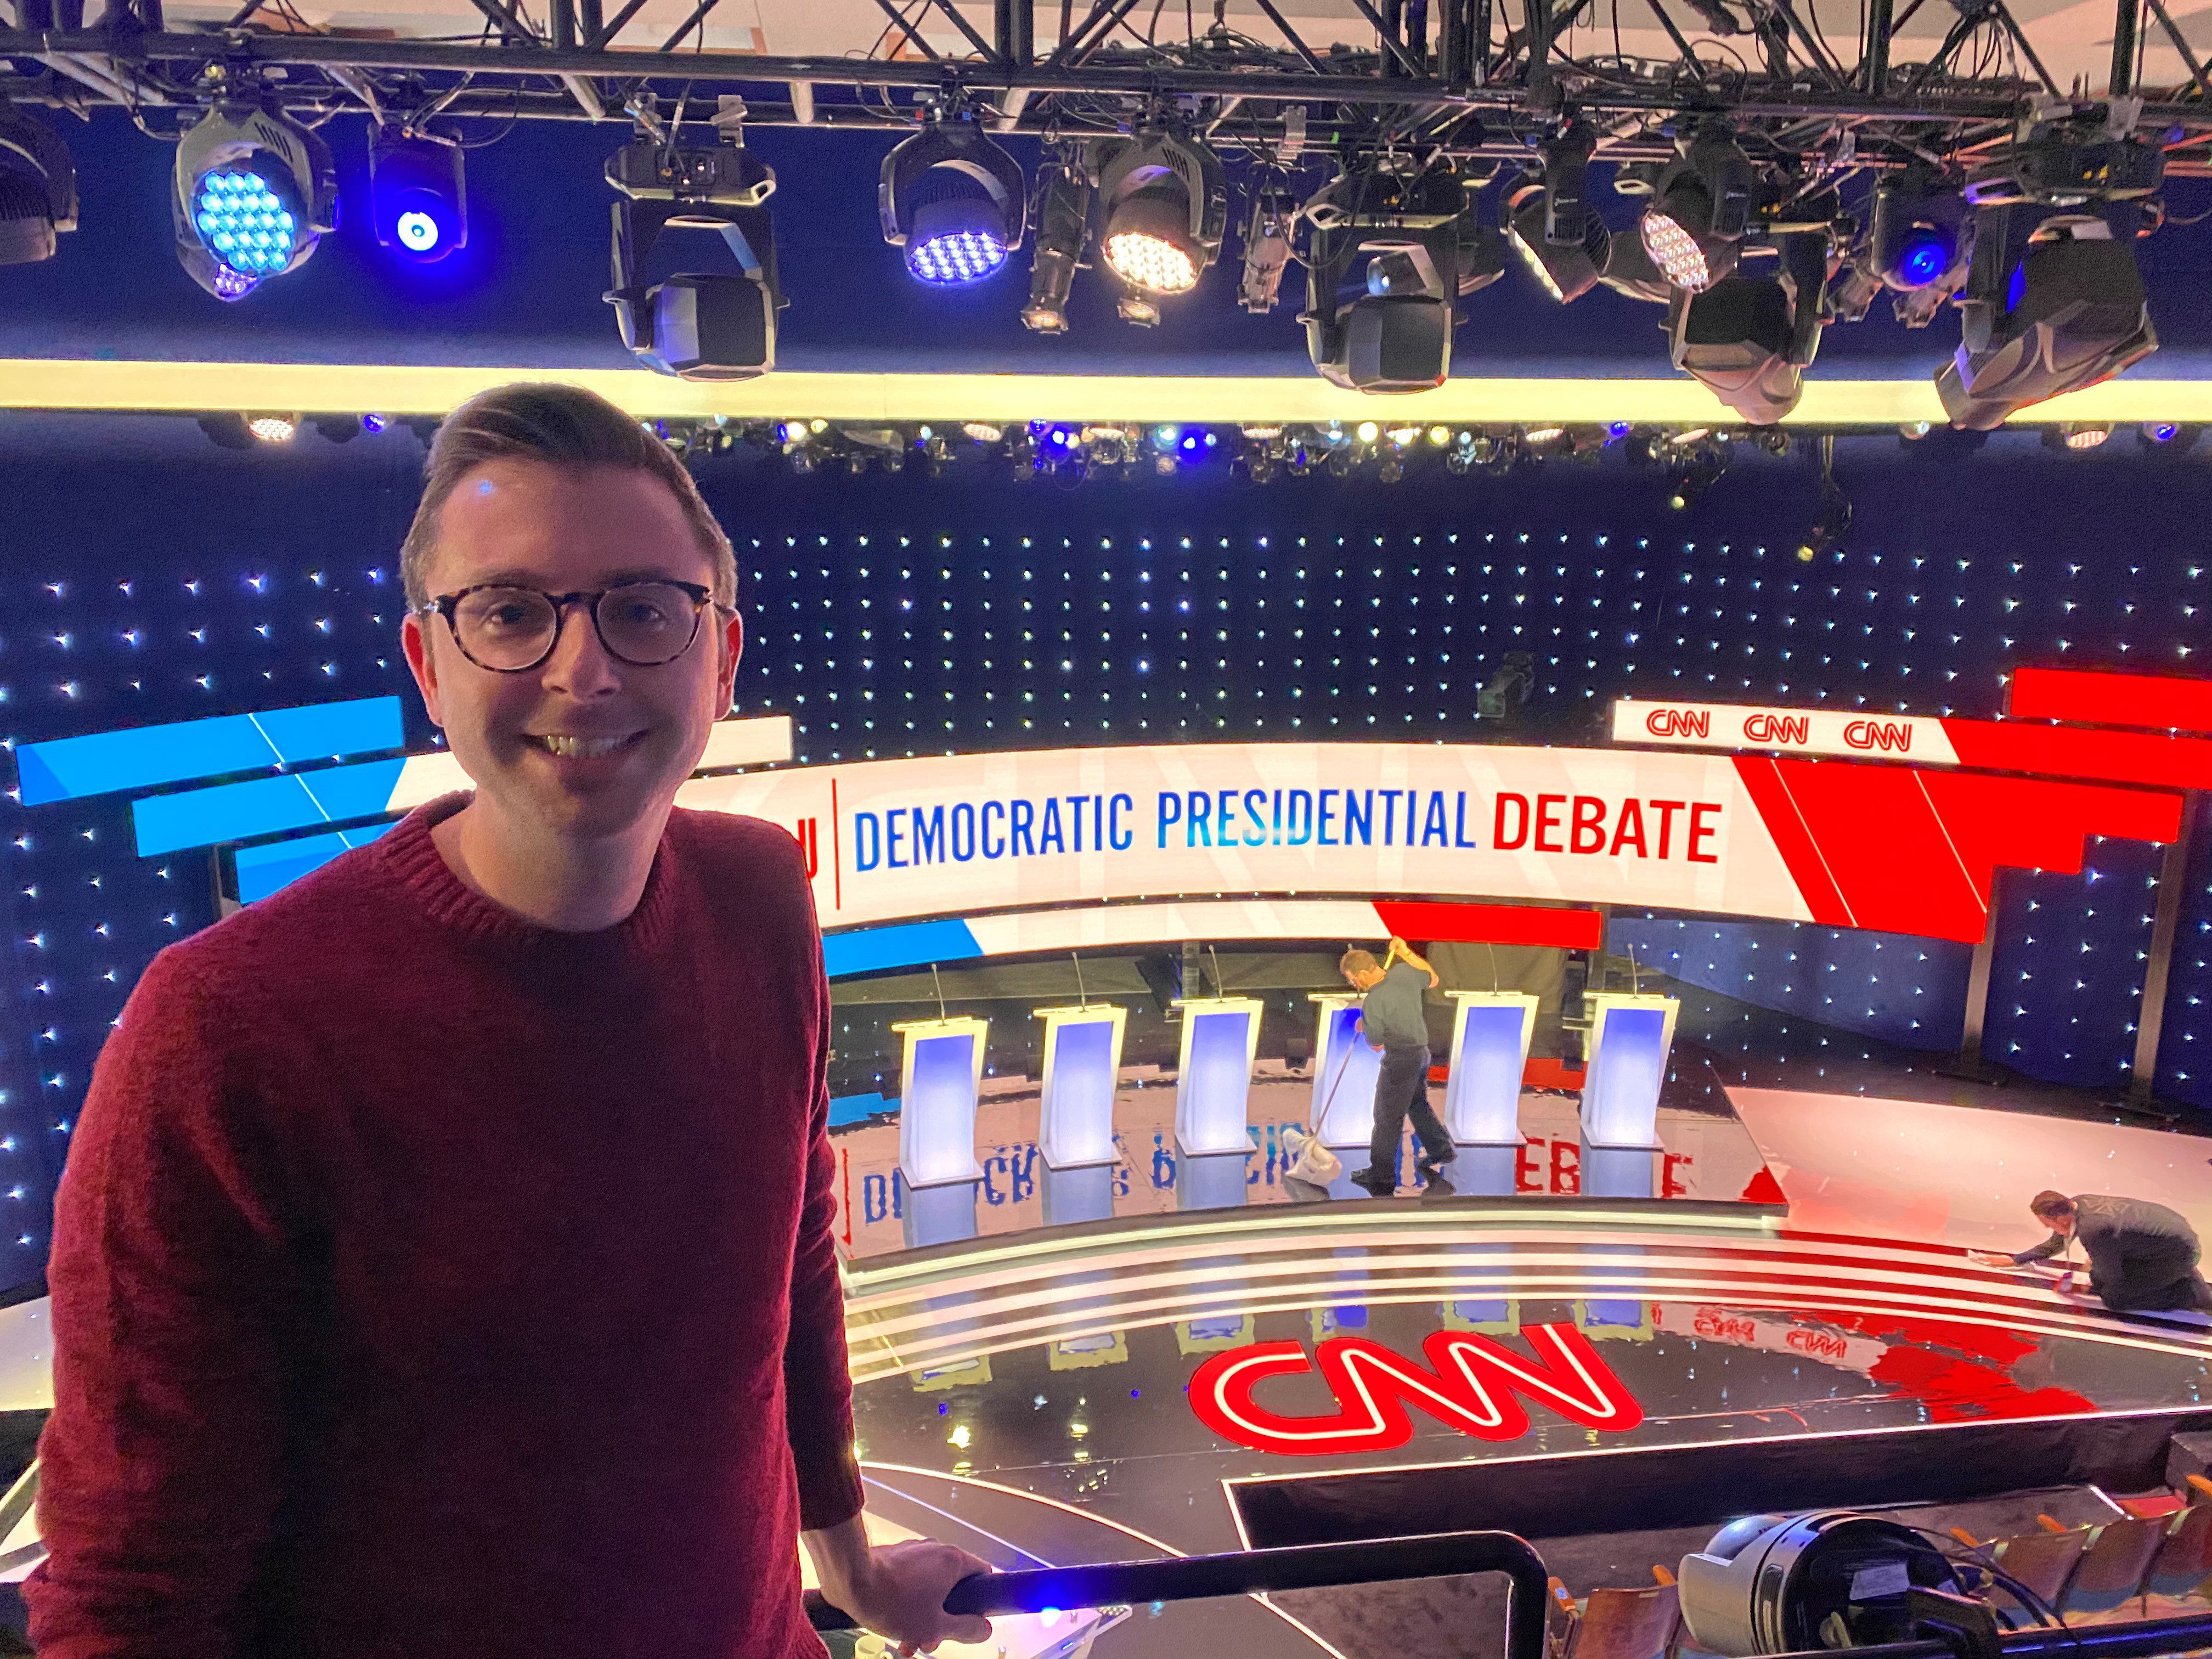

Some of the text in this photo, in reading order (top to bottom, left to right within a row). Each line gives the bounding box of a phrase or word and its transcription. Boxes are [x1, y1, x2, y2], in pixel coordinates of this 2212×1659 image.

[1647, 709, 1912, 752] CNN CNN CNN
[855, 793, 1133, 872] DEMOCRATIC
[1158, 789, 1476, 849] PRESIDENTIAL
[1493, 792, 1722, 864] DEBATE
[1187, 1322, 1645, 1456] CNN
